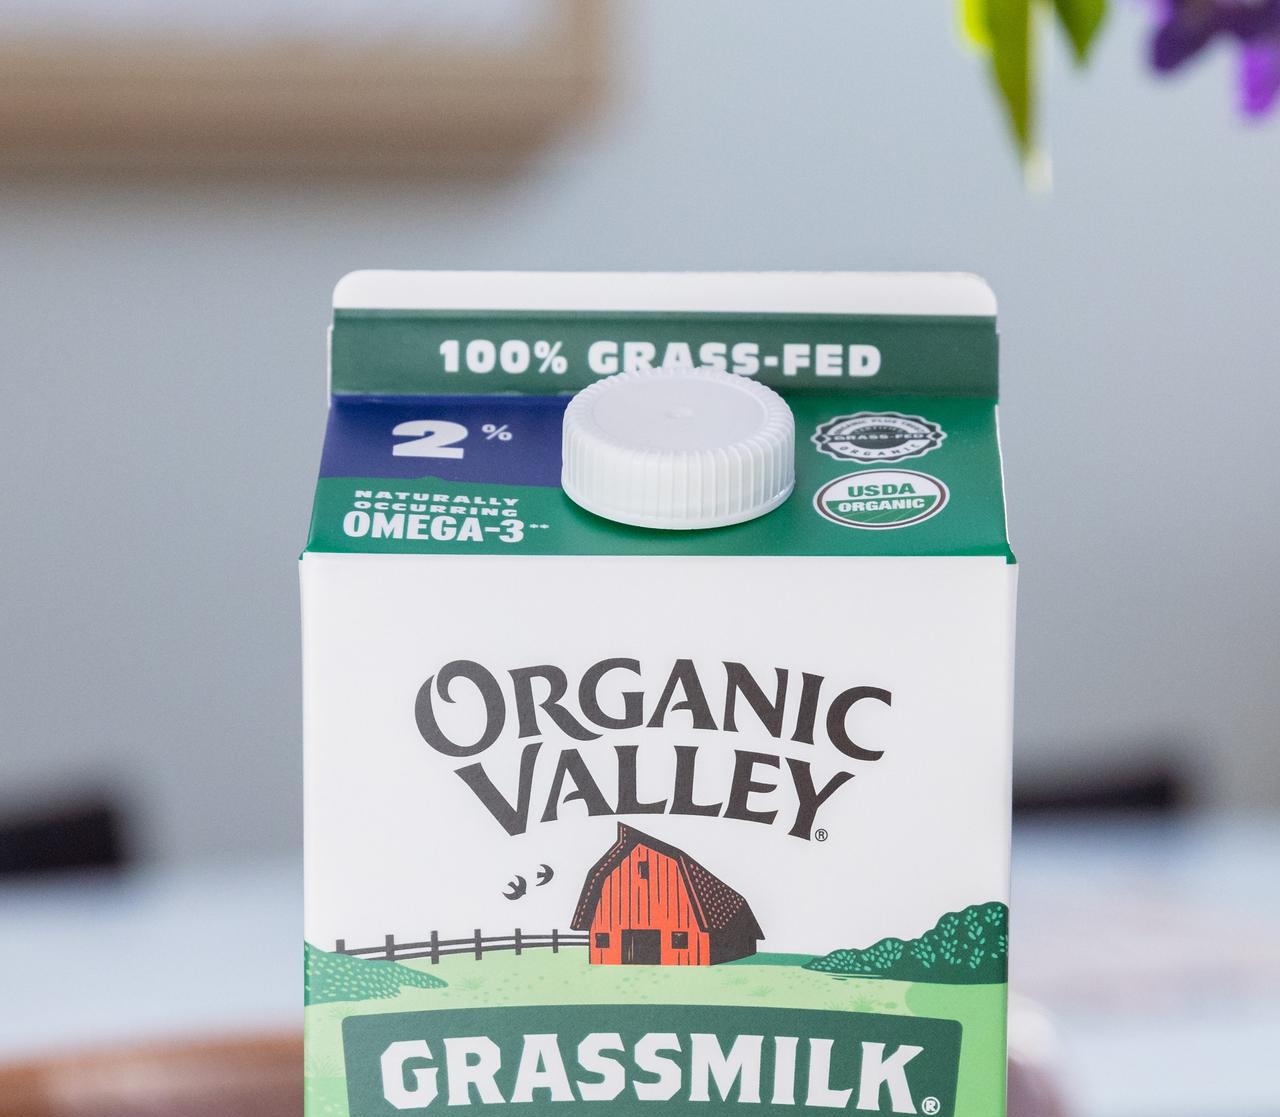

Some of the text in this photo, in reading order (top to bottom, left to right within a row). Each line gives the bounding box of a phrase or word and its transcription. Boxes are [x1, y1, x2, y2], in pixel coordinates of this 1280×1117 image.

[439, 339, 882, 376] 100% GRASS-FED
[838, 442, 922, 457] ORGANIC
[353, 490, 520, 507] NATURALLY
[847, 482, 917, 498] USDA
[353, 501, 519, 518] OCCURRING
[838, 497, 926, 513] ORGANIC
[414, 657, 893, 762] ORGANIC
